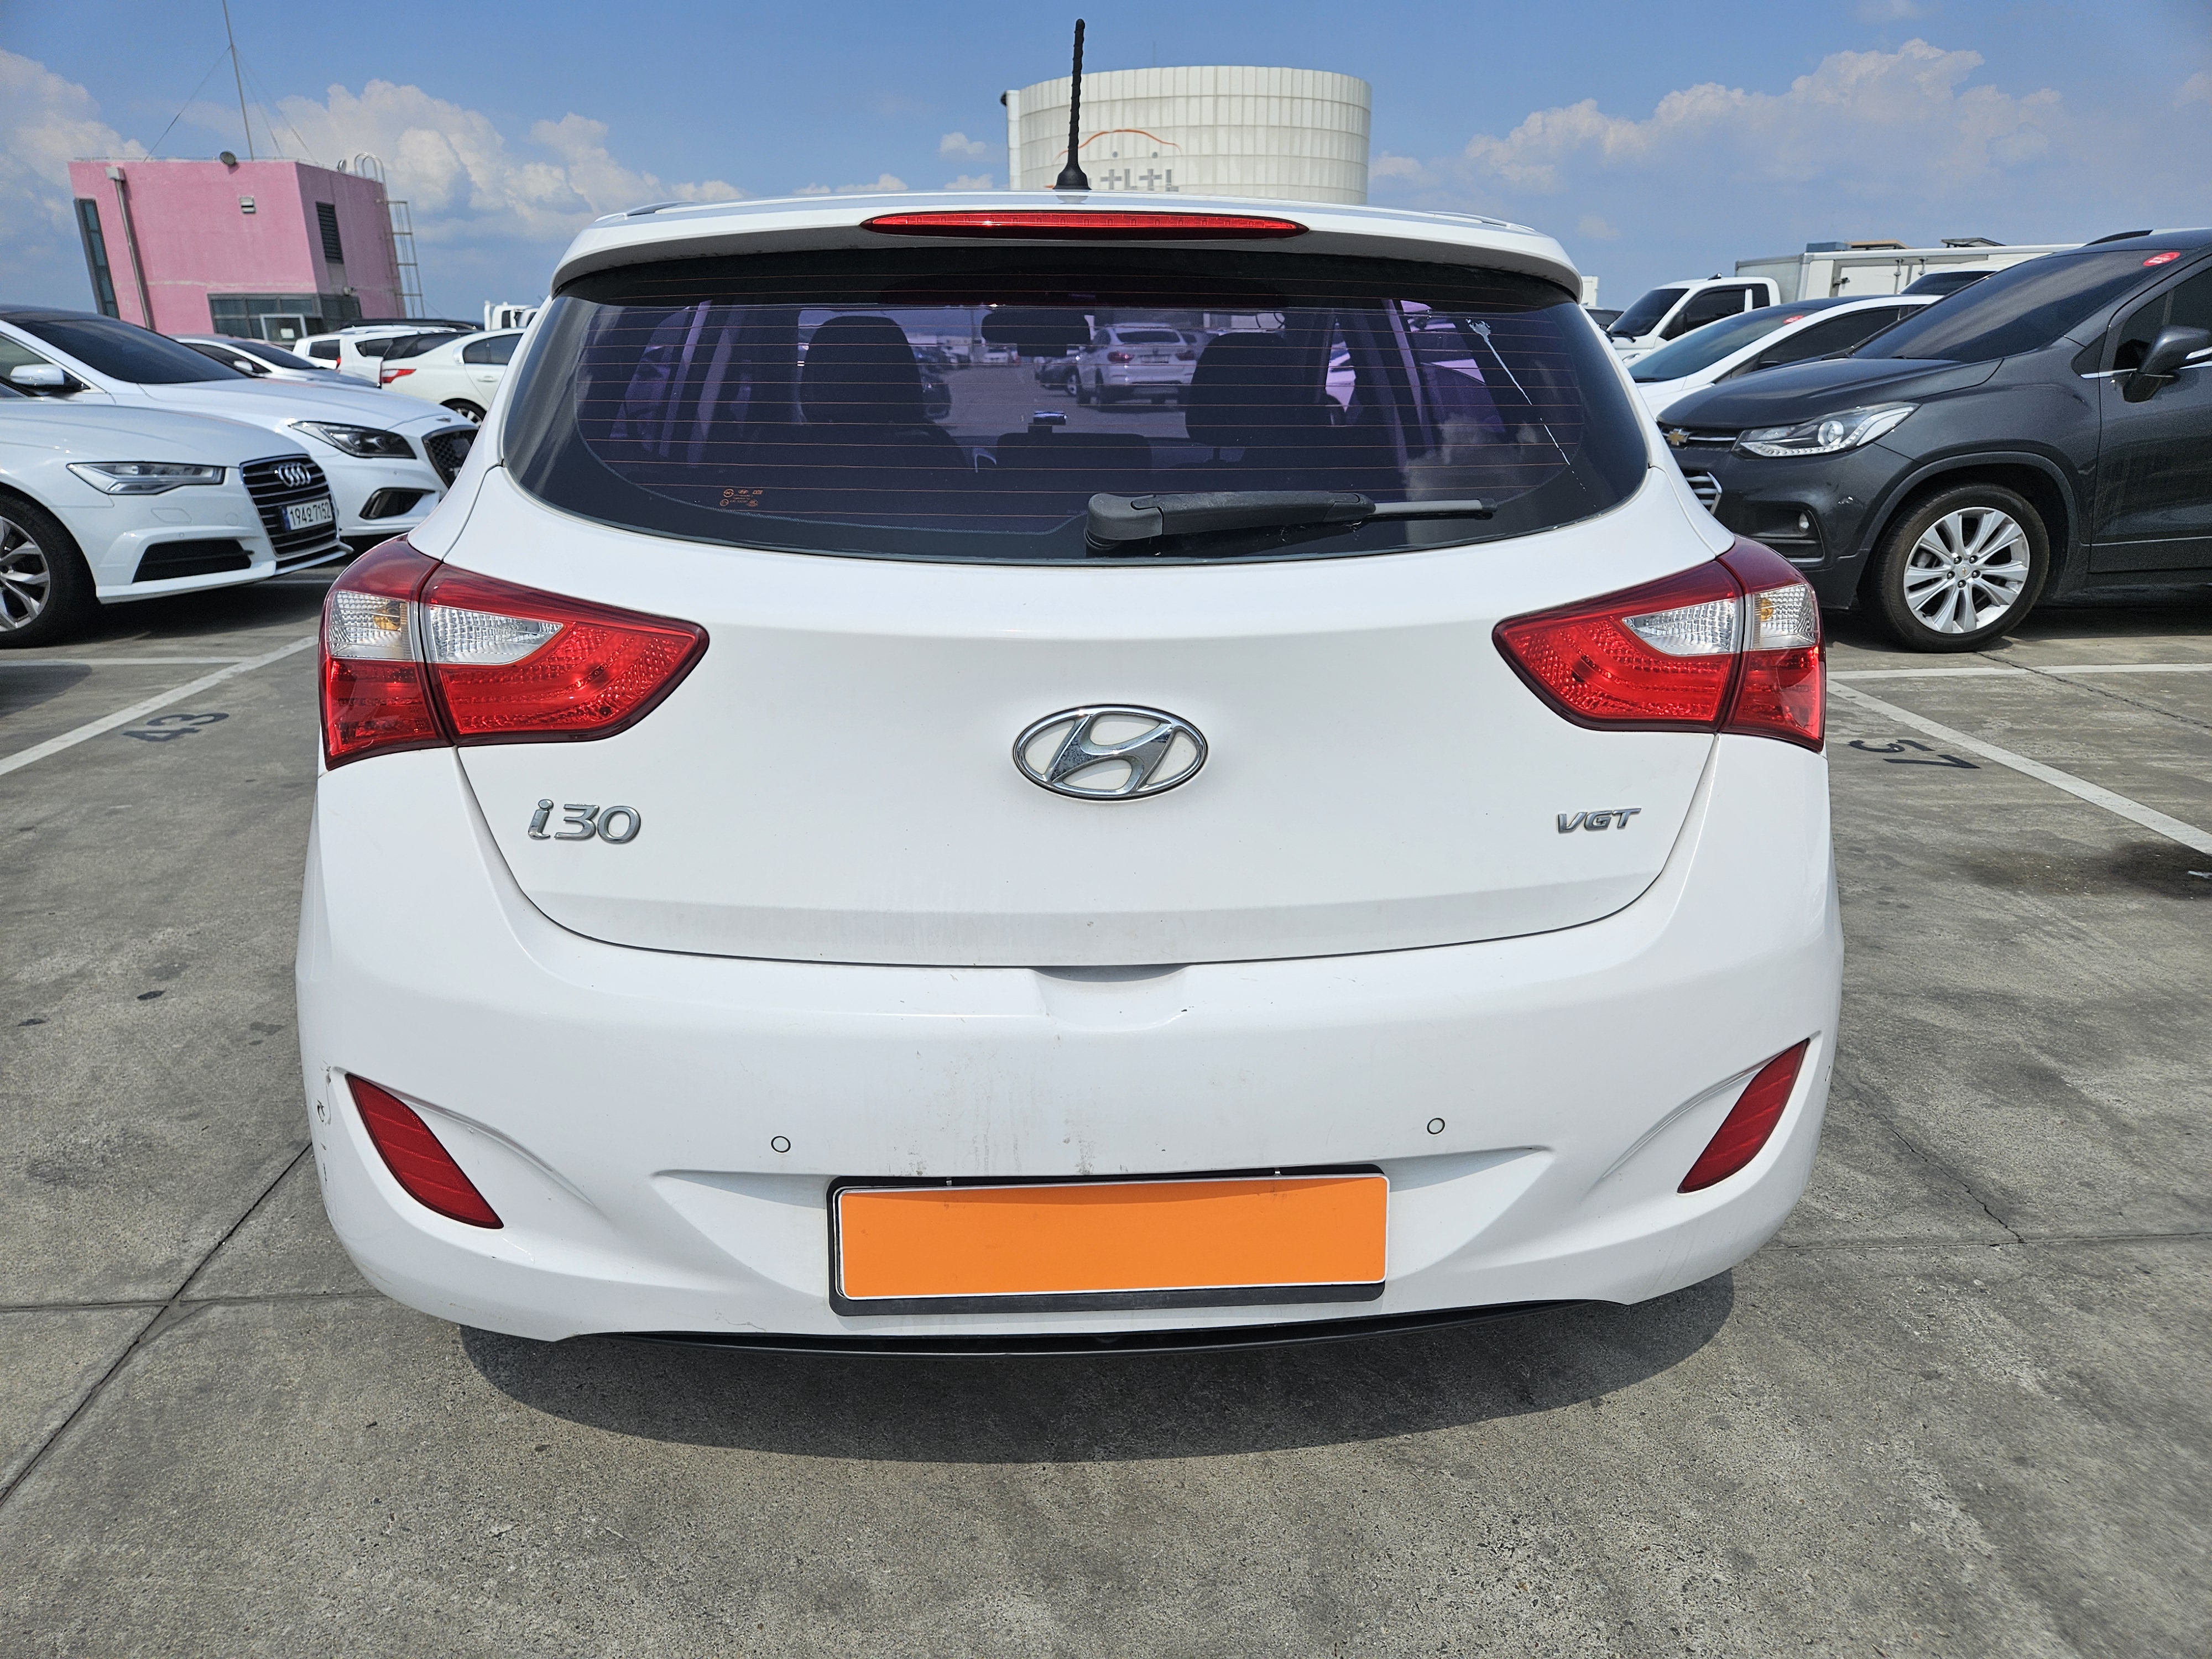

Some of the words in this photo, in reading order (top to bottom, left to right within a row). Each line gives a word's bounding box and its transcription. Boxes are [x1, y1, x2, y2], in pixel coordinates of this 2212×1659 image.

[122, 712, 229, 742] 43
[528, 799, 641, 844] i30
[1558, 808, 1642, 834] VGT
